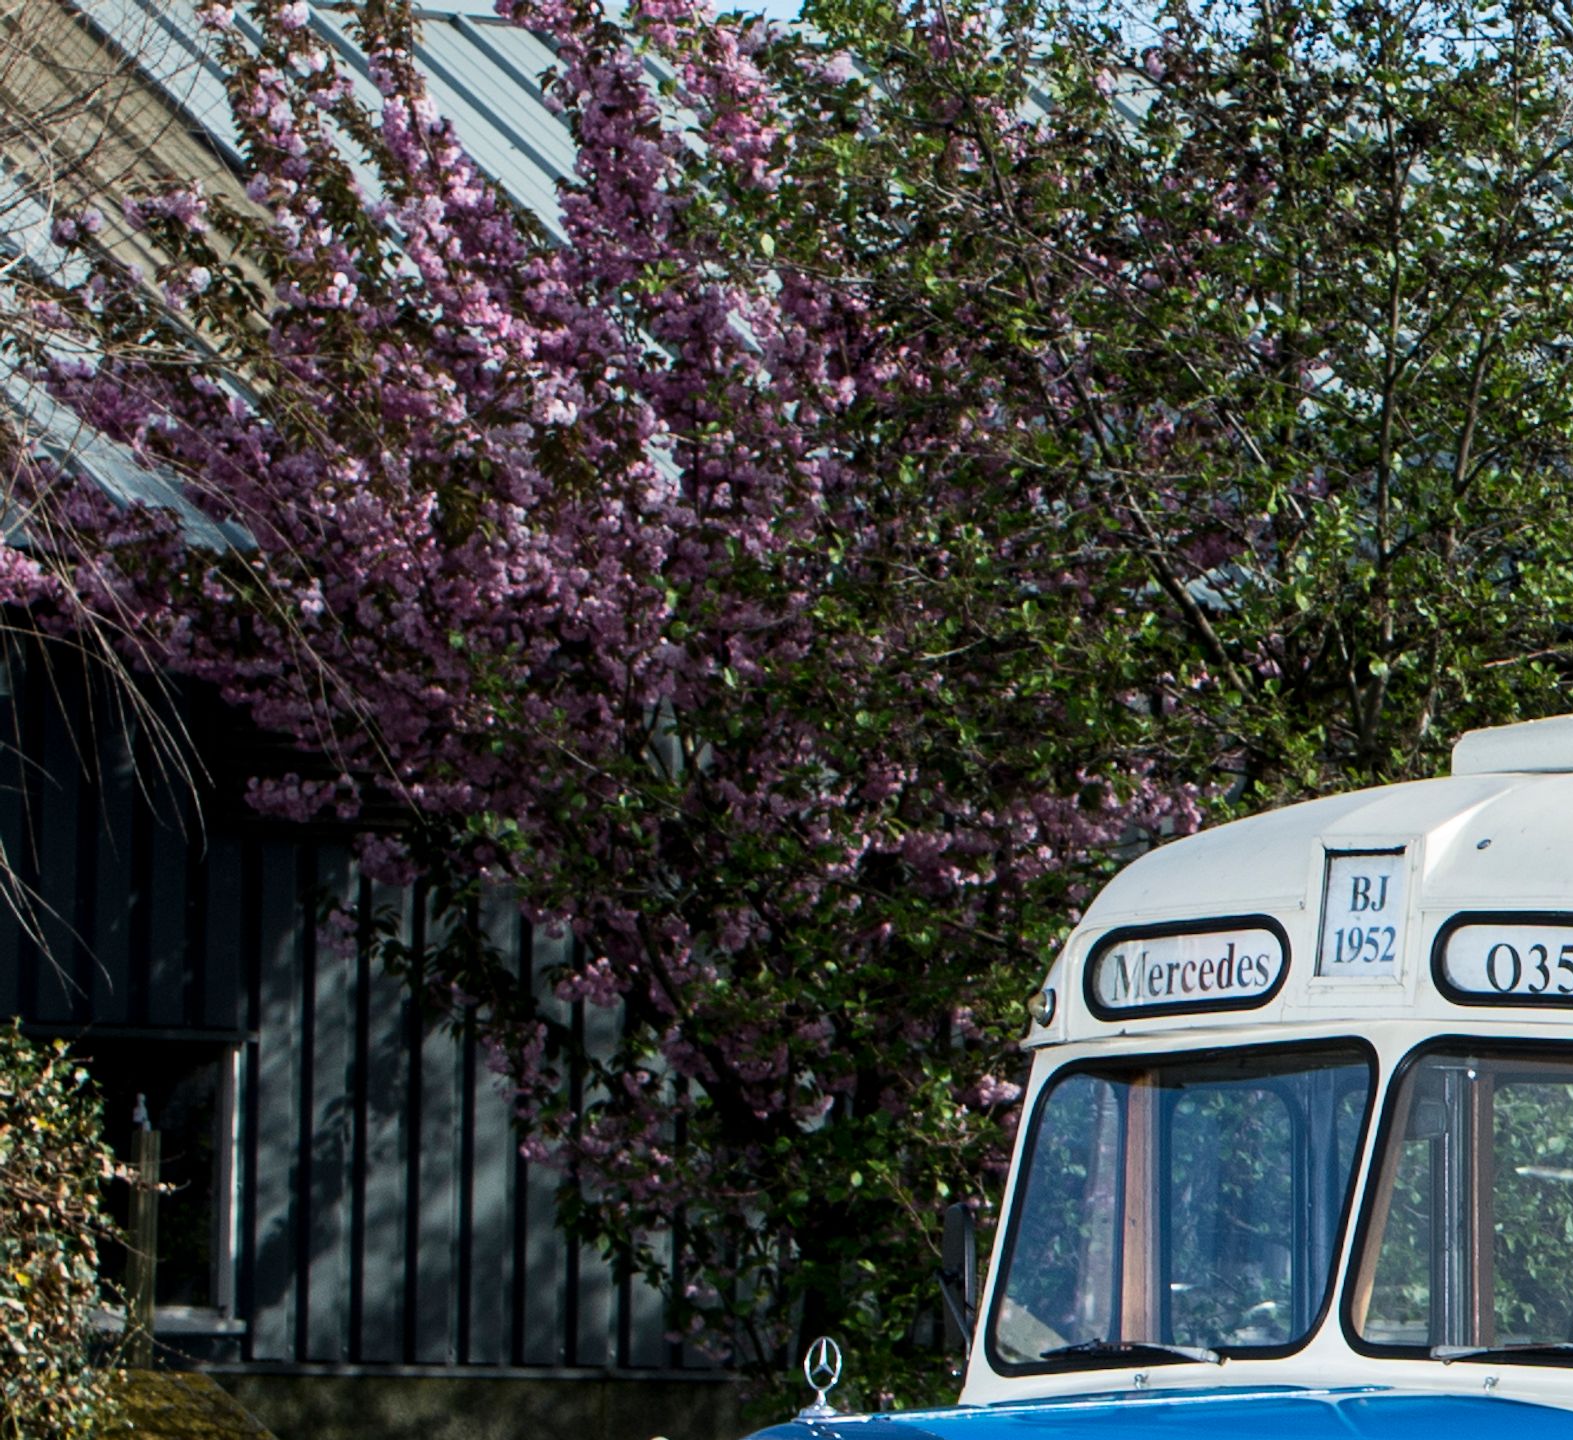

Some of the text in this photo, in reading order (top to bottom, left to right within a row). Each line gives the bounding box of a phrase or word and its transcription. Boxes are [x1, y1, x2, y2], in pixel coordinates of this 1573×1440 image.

[1350, 875, 1390, 912] BJ
[1334, 926, 1396, 963] 1952
[1112, 943, 1271, 1001] Mercedes
